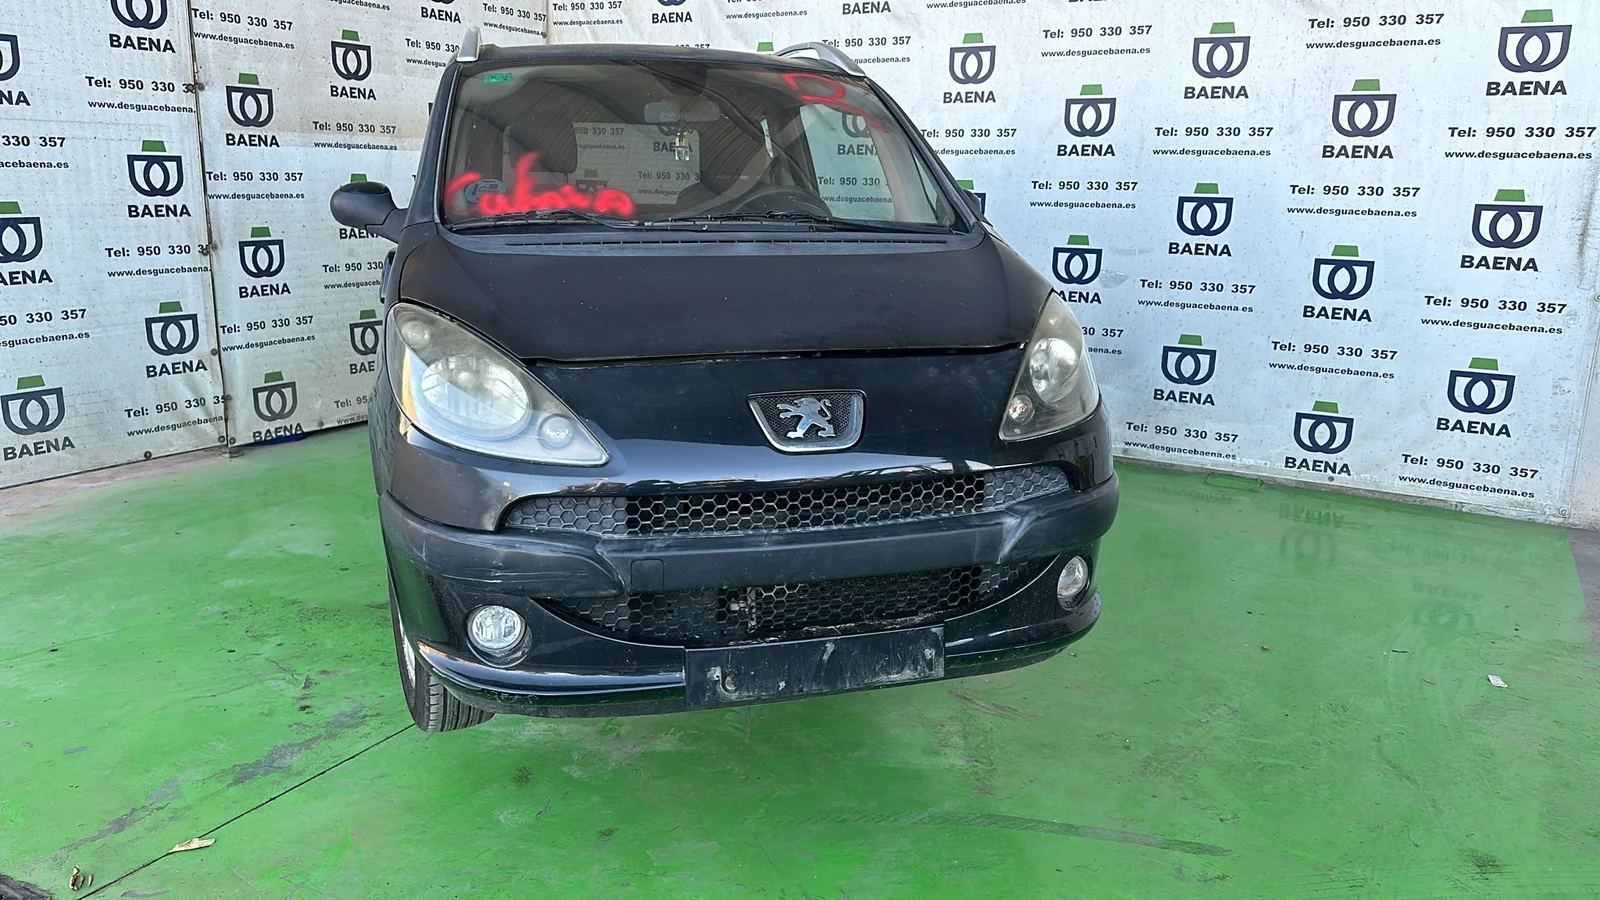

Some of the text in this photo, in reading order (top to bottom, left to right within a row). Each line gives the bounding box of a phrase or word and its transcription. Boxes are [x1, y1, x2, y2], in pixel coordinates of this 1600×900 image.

[553, 3, 565, 11] Tel:
[590, 2, 604, 10] 330
[608, 1, 622, 9] 357
[843, 1, 891, 14] BAENA
[191, 8, 292, 30] Tel: 950 330 357
[421, 7, 461, 23] BAENA
[482, 3, 548, 24] Tel: 950 330 357
[652, 12, 692, 23] BAENA
[726, 11, 807, 19] www.desguacebaena.es
[1309, 14, 1444, 28] Tel: 950 330 357
[1043, 25, 1152, 38] Tel: 950 330 357
[109, 34, 176, 53] BAENA
[193, 32, 295, 49] www.desguacebaena.es
[405, 38, 421, 48] Tel:
[426, 41, 440, 50] 950
[845, 38, 862, 47] 950
[869, 37, 886, 46] 330
[893, 36, 911, 45] 357
[1306, 39, 1440, 49] www.desguacebaena.es
[1041, 48, 1150, 57] www.desguacebaena.es
[85, 76, 111, 87] Tel:
[119, 79, 143, 90] 950
[152, 81, 174, 92] 330
[1486, 81, 1567, 96] BAENA
[331, 85, 376, 100] BAENA
[943, 91, 996, 103] BAENA
[1184, 86, 1249, 99] BAENA
[313, 121, 396, 134] Tel: 950 330 357
[920, 129, 1017, 138] Tel: 950 330 357
[1155, 127, 1273, 136] Tel: 950 330 357
[1449, 127, 1596, 137] Tel: 950 330 357
[2, 136, 65, 147] 330 357
[226, 133, 279, 147] BAENA
[314, 142, 397, 150] www.desguacebaena.es
[1057, 145, 1115, 156] BAENA
[1153, 148, 1270, 156] www.desguacebaena.es
[1322, 145, 1393, 158] BAENA
[1445, 151, 1592, 160] www.desguacebaena.es
[206, 172, 303, 181] Tel: 950 330 357
[656, 172, 671, 180] 950
[676, 172, 690, 180] 330
[840, 177, 857, 185] 950
[863, 178, 880, 186] 330
[1032, 181, 1137, 190] Tel: 950 330 357
[1290, 185, 1420, 197] Tel: 950 330 357
[208, 192, 305, 200] www.desguacebaena.es
[128, 204, 191, 217] BAENA
[1030, 201, 1135, 209] www.desguacebaena.es
[1287, 207, 1416, 217] www.desguacebaena.es
[105, 248, 129, 257] Tel:
[137, 246, 160, 256] 950
[169, 245, 190, 254] 330
[1169, 242, 1231, 256] BAENA
[323, 262, 383, 272] Tel: 950 330
[1461, 255, 1538, 272] BAENA
[239, 283, 291, 298] BAENA
[1140, 279, 1255, 294] Tel: 950 330 357
[1425, 296, 1566, 313] Tel: 950 330 357
[26, 309, 86, 323] 330 357
[1303, 306, 1371, 322] BAENA
[220, 316, 313, 334] Tel: 950 330 357
[1421, 319, 1562, 334] www.desguacebaena.es
[1102, 328, 1123, 337] 357
[222, 336, 315, 351] www.desguacebaena.es
[1272, 341, 1397, 359] Tel: 950 330 357
[146, 360, 207, 378] BAENA
[1269, 363, 1394, 378] www.desguacebaena.es
[334, 399, 351, 408] Tel:
[1154, 389, 1215, 406] BAENA
[125, 407, 148, 418] Tel:
[156, 402, 177, 413] 950
[185, 398, 205, 408] 330
[252, 422, 305, 443] BAENA
[1126, 422, 1238, 442] Tel: 950 330 357
[1437, 418, 1511, 437] BAENA
[3, 437, 75, 461] BAENA
[1124, 441, 1236, 459] www.desguacebaena.es
[1285, 457, 1351, 476] BAENA
[1402, 454, 1538, 478] Tel: 950 330 357
[1398, 475, 1535, 498] www.desguacebaena.es
